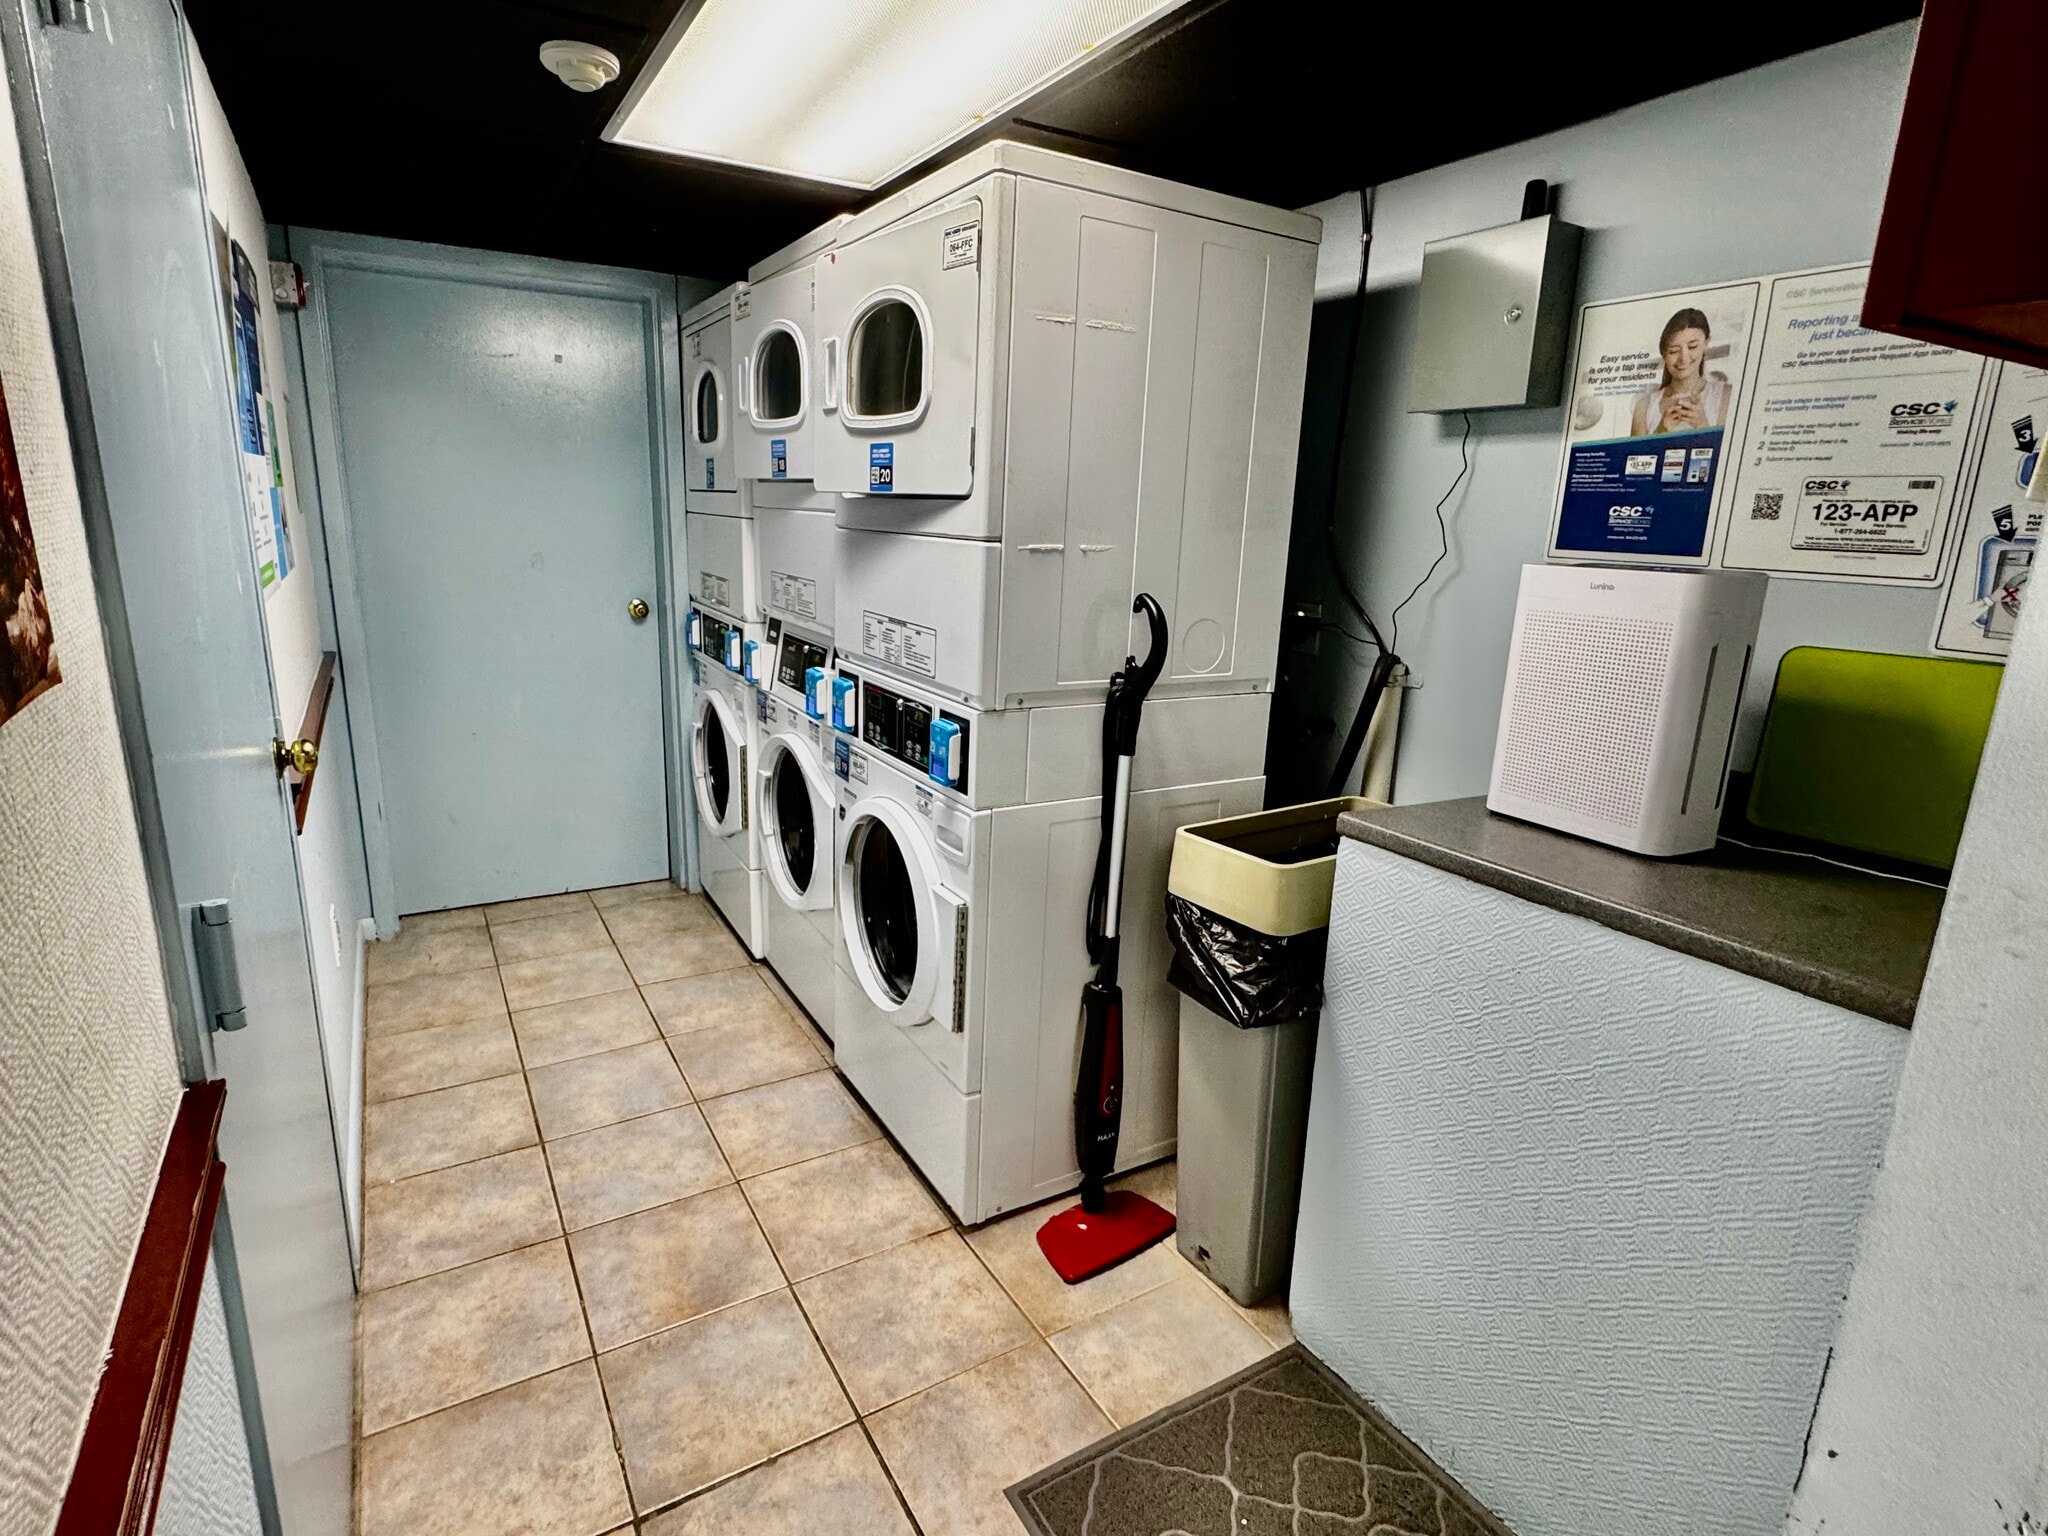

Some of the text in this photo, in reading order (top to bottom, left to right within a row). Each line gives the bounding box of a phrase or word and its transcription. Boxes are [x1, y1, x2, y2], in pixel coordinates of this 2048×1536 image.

[1788, 314, 1859, 329] Reporting a
[1808, 328, 1878, 343] just becam
[1600, 352, 1650, 364] Easy service
[1597, 365, 1613, 374] only
[1622, 364, 1635, 372] tap
[1636, 362, 1659, 370] away
[1600, 377, 1617, 385] your
[1619, 372, 1657, 380] residents
[1890, 402, 1941, 416] CSC
[1763, 425, 1768, 434] 1
[2018, 429, 2031, 442] 3
[1757, 441, 1765, 450] 2
[1754, 457, 1762, 466] 3
[880, 468, 891, 482] 20
[1805, 480, 1839, 490] CSC
[1609, 506, 1643, 516] CSC
[1812, 503, 1918, 522] 123-APP
[2000, 518, 2011, 531] 5
